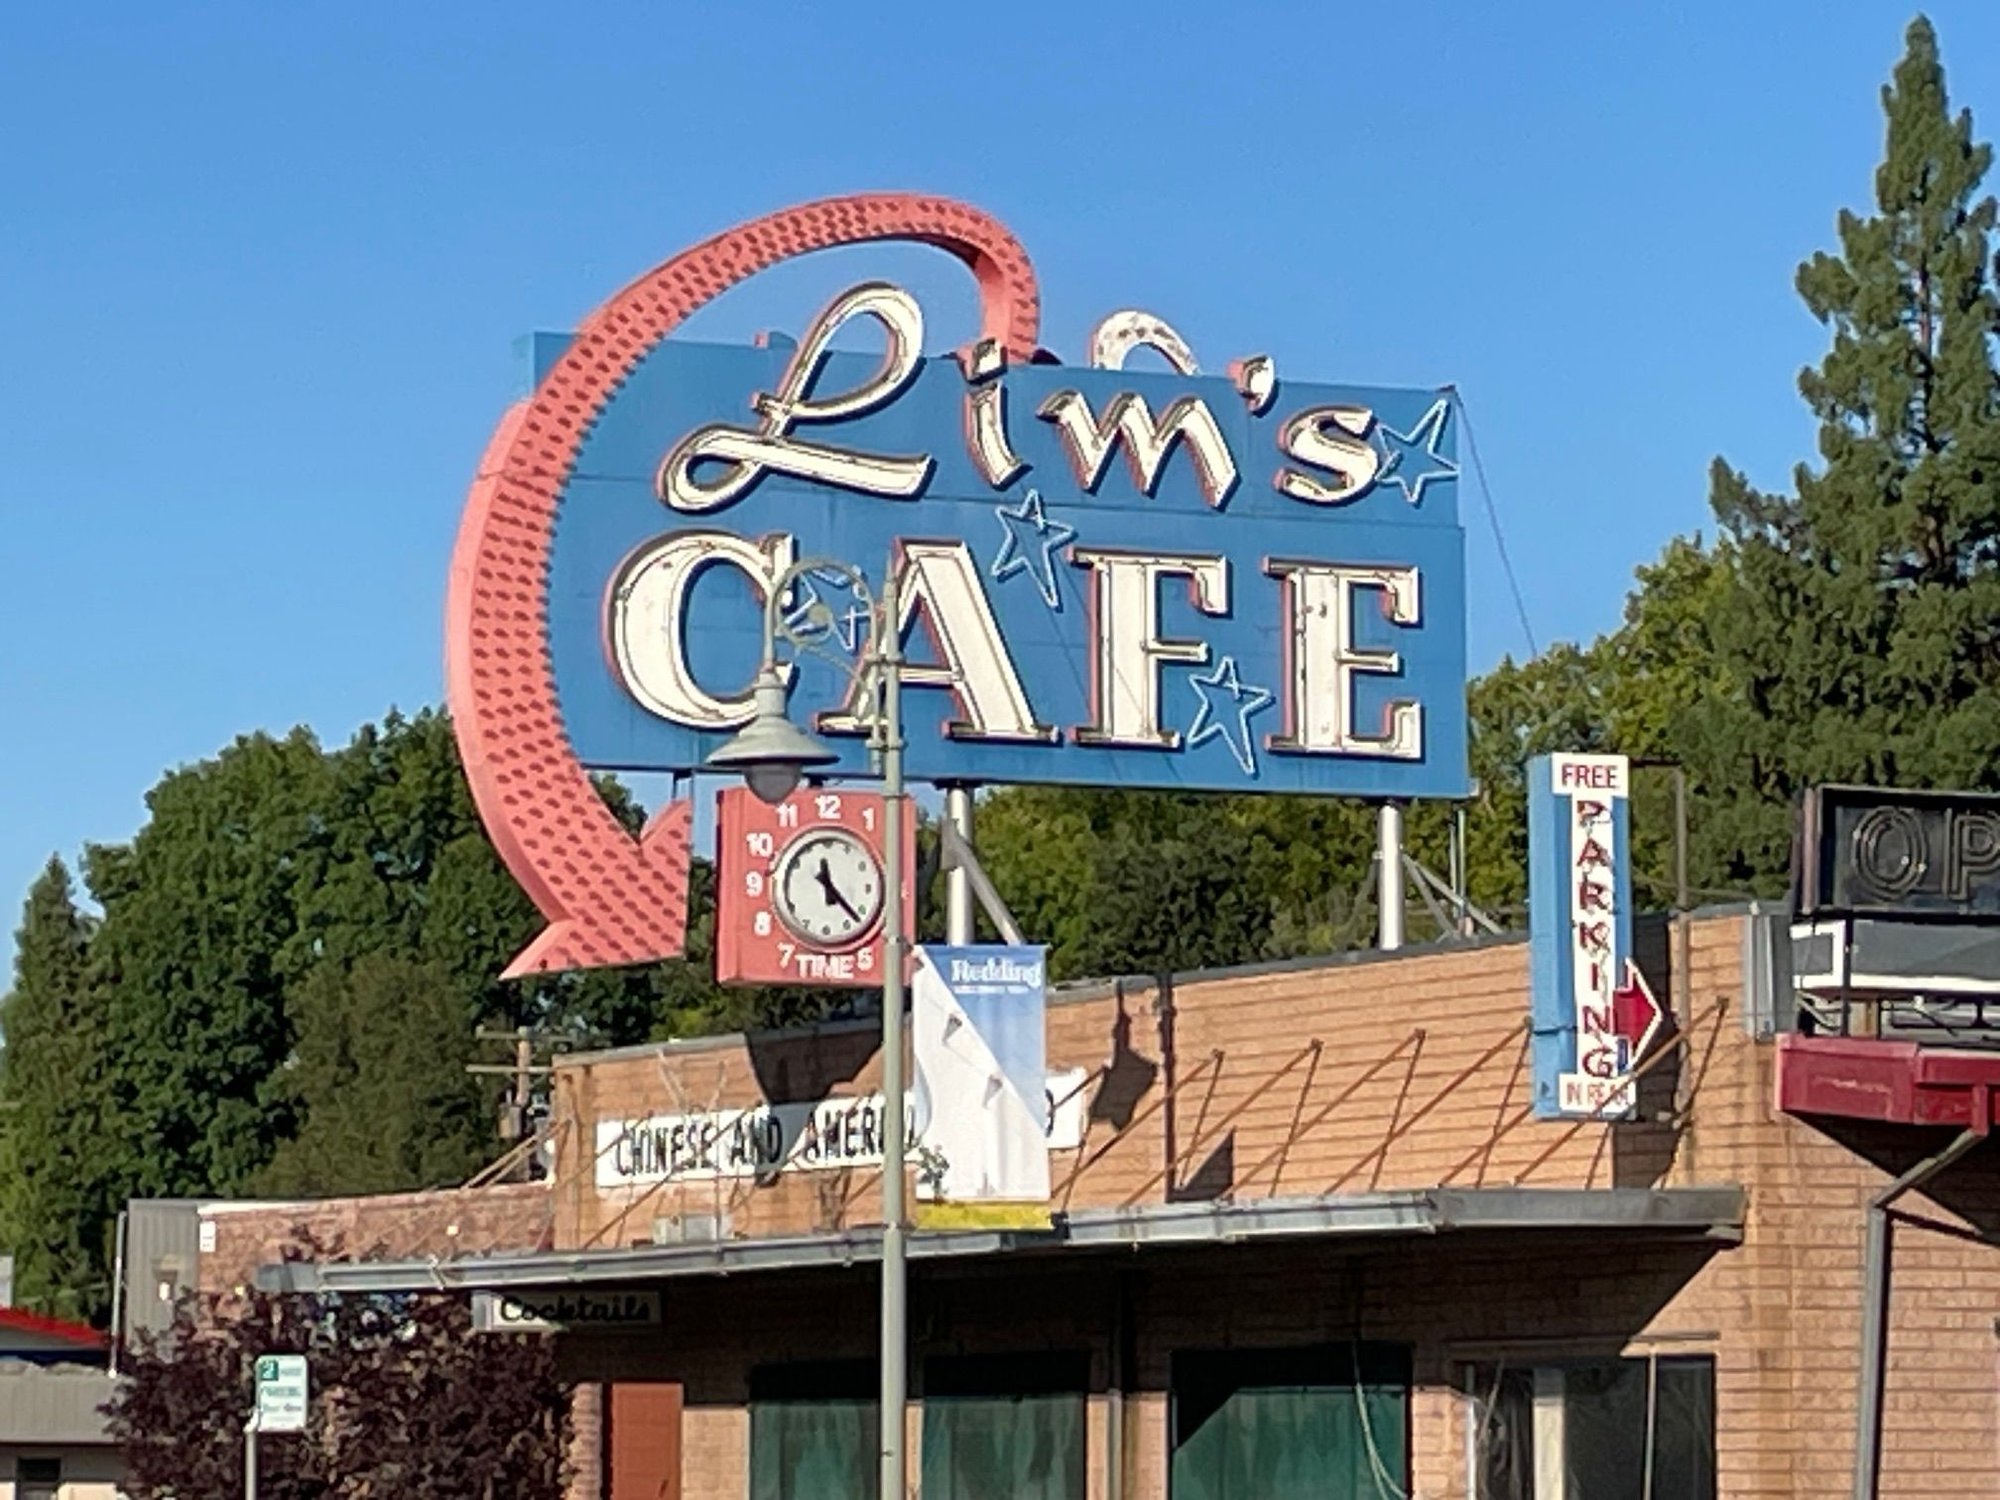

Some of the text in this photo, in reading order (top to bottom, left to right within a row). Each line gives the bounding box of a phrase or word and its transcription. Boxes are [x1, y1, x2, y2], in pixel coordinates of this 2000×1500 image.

[656, 281, 1380, 514] Lim's
[603, 527, 1423, 760] CAFE
[1561, 763, 1619, 789] FREE
[776, 803, 799, 828] 11
[815, 794, 841, 820] 12
[862, 807, 875, 832] 1
[746, 832, 773, 858] 10
[746, 871, 764, 897] 9
[754, 911, 771, 936] 8
[1576, 800, 1614, 1079] PARKING
[777, 942, 796, 969] 7
[794, 953, 855, 979] TIME
[951, 957, 1041, 989] Redding
[616, 1119, 719, 1176] CHINESE
[730, 1115, 782, 1168] AND
[500, 1294, 651, 1322] Cocktails
